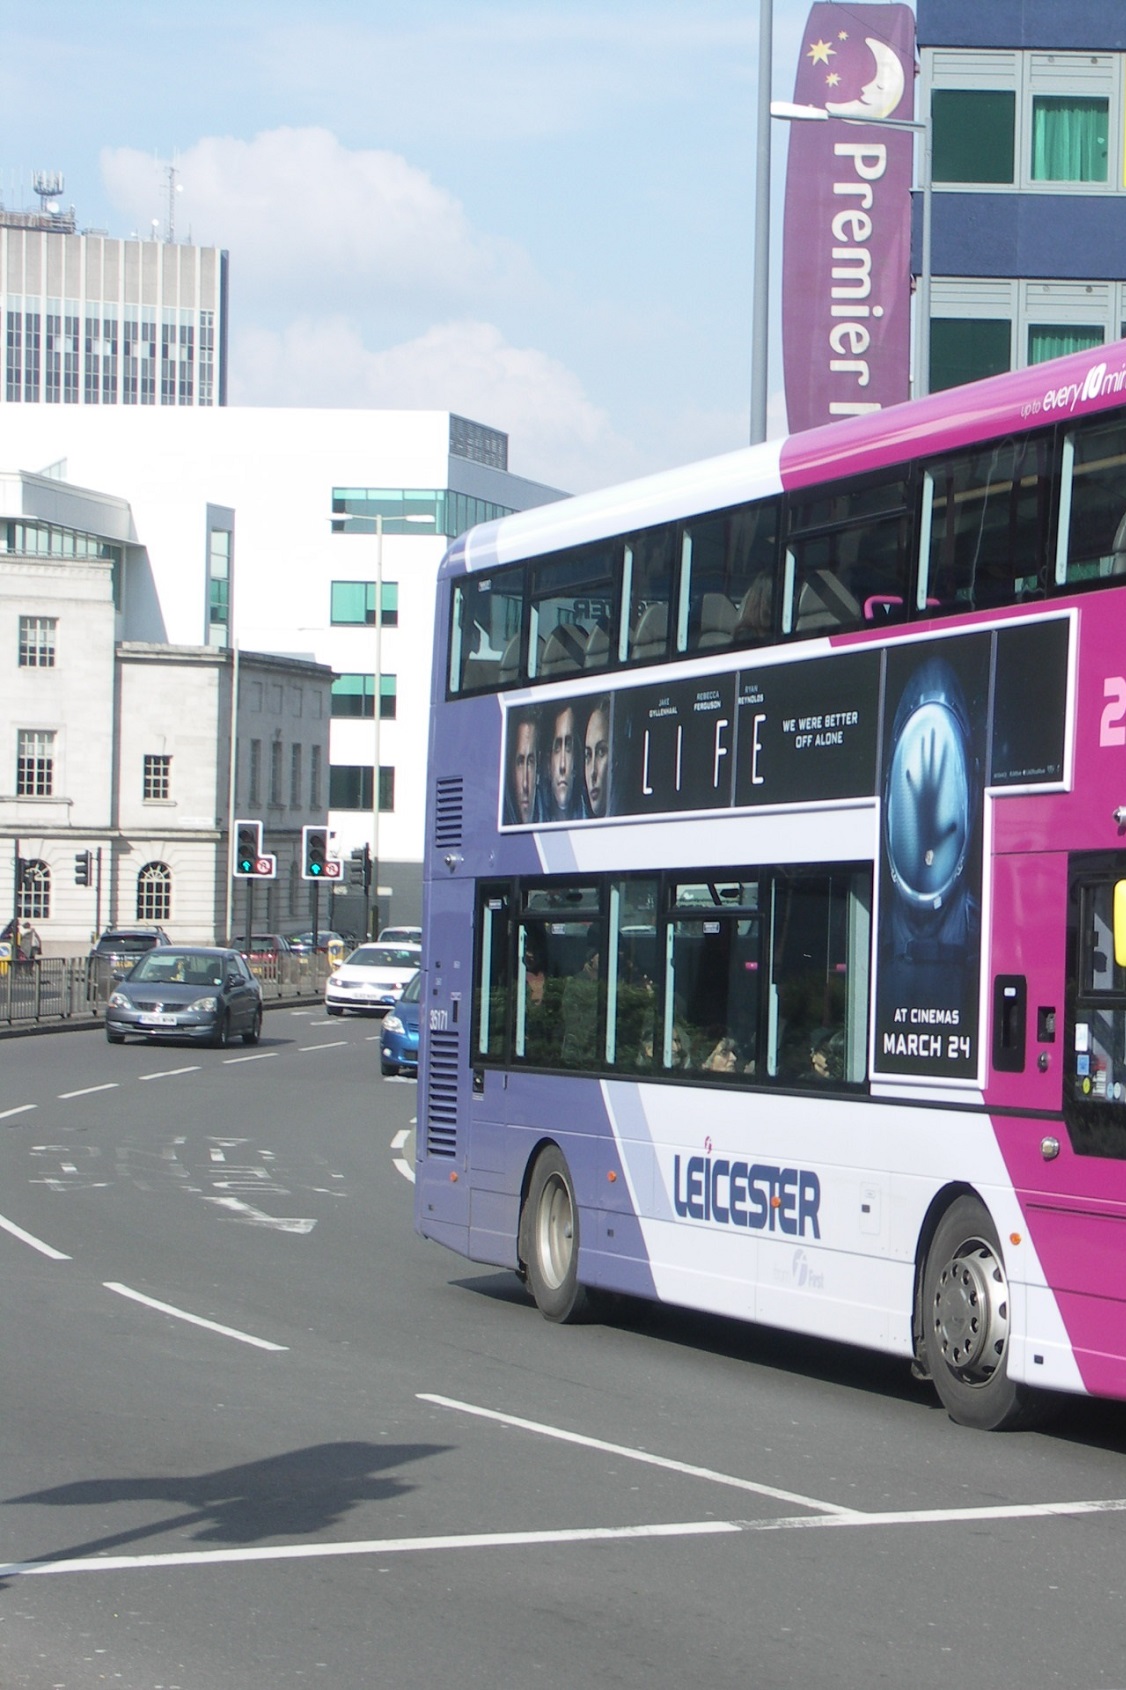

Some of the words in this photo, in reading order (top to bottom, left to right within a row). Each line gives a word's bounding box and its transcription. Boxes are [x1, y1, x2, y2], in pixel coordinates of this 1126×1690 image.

[828, 142, 887, 387] Premier
[1042, 382, 1083, 413] every
[1081, 362, 1107, 402] 10
[658, 698, 670, 708] JAKE
[696, 690, 720, 701] REBECCA
[738, 693, 764, 705] REYNOLDS
[648, 706, 678, 718] GYLLENHAAL
[693, 700, 721, 712] FERGUSON
[782, 719, 796, 732] WE
[798, 715, 823, 731] WERE
[824, 711, 859, 728] BETTER
[795, 734, 813, 749] OFF
[814, 730, 844, 747] ALONE
[643, 713, 766, 795] LIFE
[429, 1008, 448, 1031] 35171
[893, 1007, 908, 1022] AT
[910, 1008, 960, 1025] CINEMAS
[883, 1032, 942, 1058] MARCH
[947, 1035, 970, 1059] 24
[674, 1153, 821, 1240] LEICESTER
